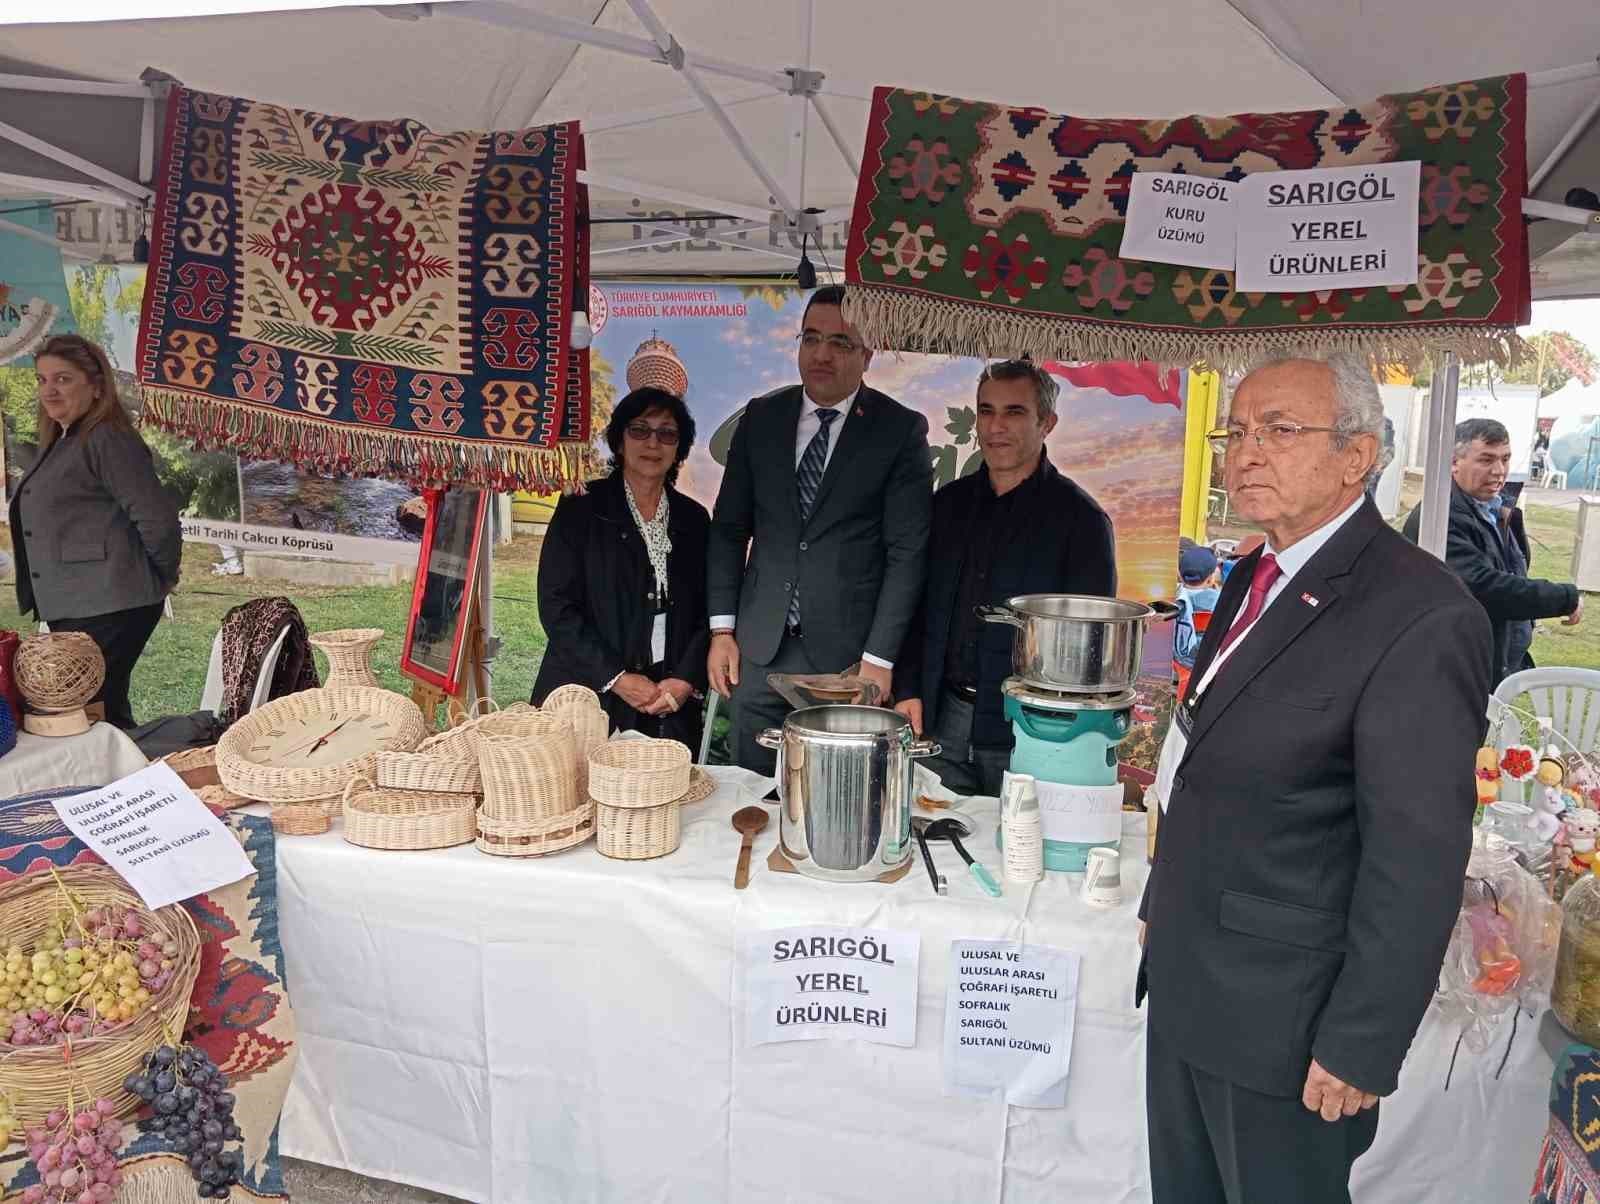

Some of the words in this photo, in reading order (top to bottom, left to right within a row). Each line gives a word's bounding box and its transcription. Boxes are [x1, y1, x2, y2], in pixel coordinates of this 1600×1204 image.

[1152, 178, 1229, 201] SARIGÖL
[1267, 173, 1395, 205] SARIGÖL
[1165, 206, 1205, 223] KURU
[1158, 227, 1205, 244] ÜZÜMÜ
[1291, 220, 1368, 240] YEREL
[1269, 249, 1387, 275] ÜRÜNLERİ
[612, 289, 651, 302] TÜRKİYE
[612, 303, 658, 317] SARIGÖL
[662, 303, 747, 317] KAYMAKAMLIĞI
[204, 527, 238, 541] Tarihi
[242, 531, 278, 545] Çakıcı
[282, 535, 334, 551] Köprüsü
[68, 798, 110, 816] ULUSAL
[108, 791, 123, 800] VE
[78, 804, 125, 827] ULUSLAR
[126, 790, 156, 808] ARASI
[89, 814, 135, 837] ÇOĞRAFİ
[135, 793, 178, 819] İŞARETLİ
[101, 825, 150, 846] SOFRALIK
[172, 828, 211, 848] ÜZÜMÜ
[116, 836, 160, 857] SARIGÖL
[774, 936, 896, 965] SARIGÖL
[961, 950, 1003, 960] ULUSAL
[1006, 952, 1021, 962] VE
[796, 973, 870, 994] YEREL
[960, 966, 1009, 977] ULUSLAR
[1012, 970, 1045, 981] ARASI
[960, 981, 1008, 993] ÇOĞRAFİ
[1010, 984, 1057, 999] İŞARETLİ
[776, 1002, 888, 1027] ÜRÜNLERİ
[959, 1000, 1010, 1012] SOFRALIK
[961, 1018, 1008, 1030] SARIGÖL
[960, 1036, 1006, 1048] SULTANİ
[1009, 1038, 1051, 1054] ÜZÜMÜ
